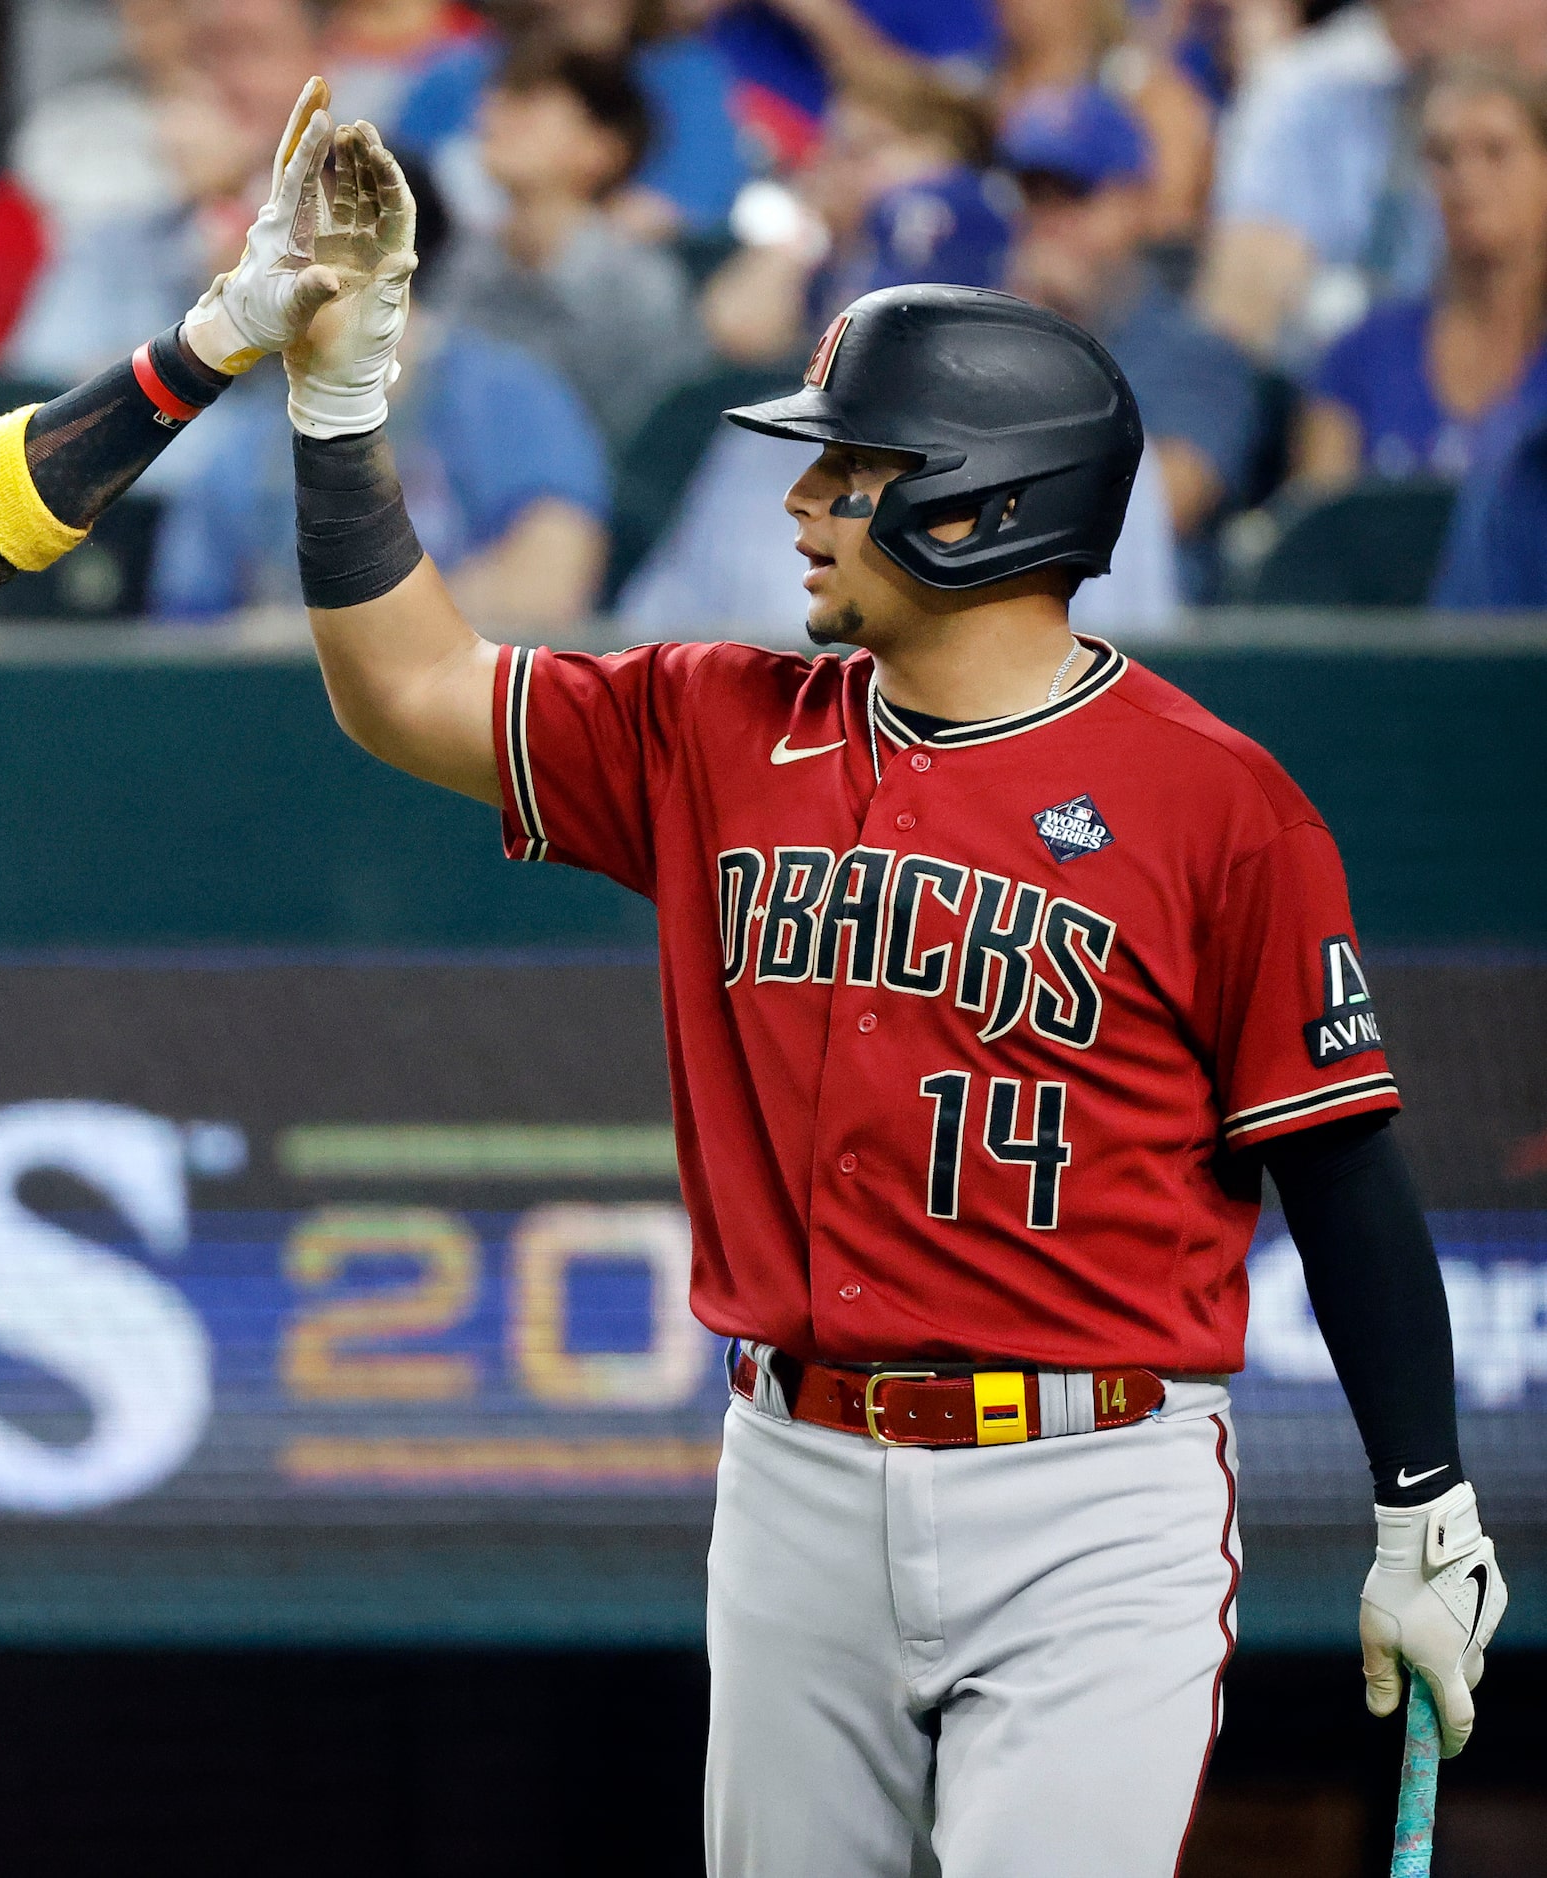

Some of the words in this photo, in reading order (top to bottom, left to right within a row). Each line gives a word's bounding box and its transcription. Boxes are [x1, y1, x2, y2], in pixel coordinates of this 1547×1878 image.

[1038, 822, 1102, 850] SERIES
[1045, 809, 1107, 838] WORLD
[1319, 1012, 1382, 1057] AVN
[919, 1070, 1072, 1230] 14
[1098, 1378, 1127, 1414] 14
